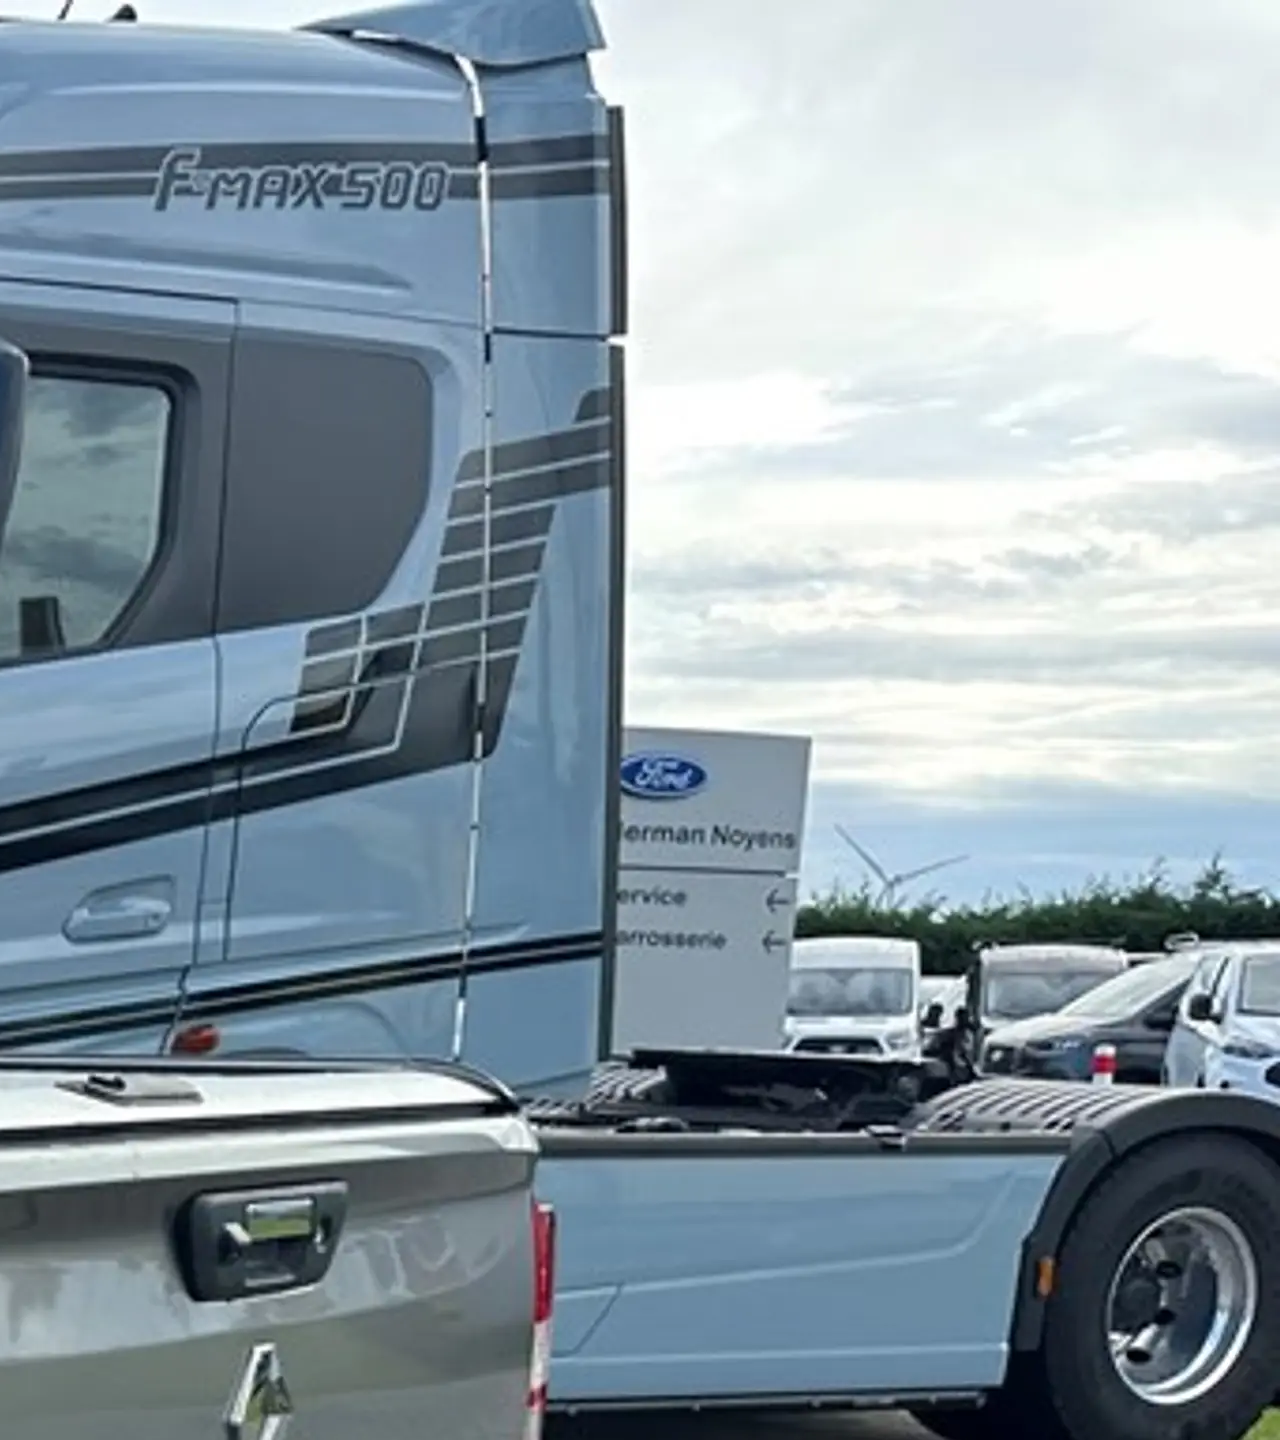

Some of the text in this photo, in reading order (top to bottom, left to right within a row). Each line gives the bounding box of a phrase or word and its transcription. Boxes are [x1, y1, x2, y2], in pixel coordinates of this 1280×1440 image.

[634, 756, 694, 789] Ford
[619, 822, 797, 852] erman Noyens
[616, 884, 688, 908] ervice
[615, 930, 728, 951] arrosserie
